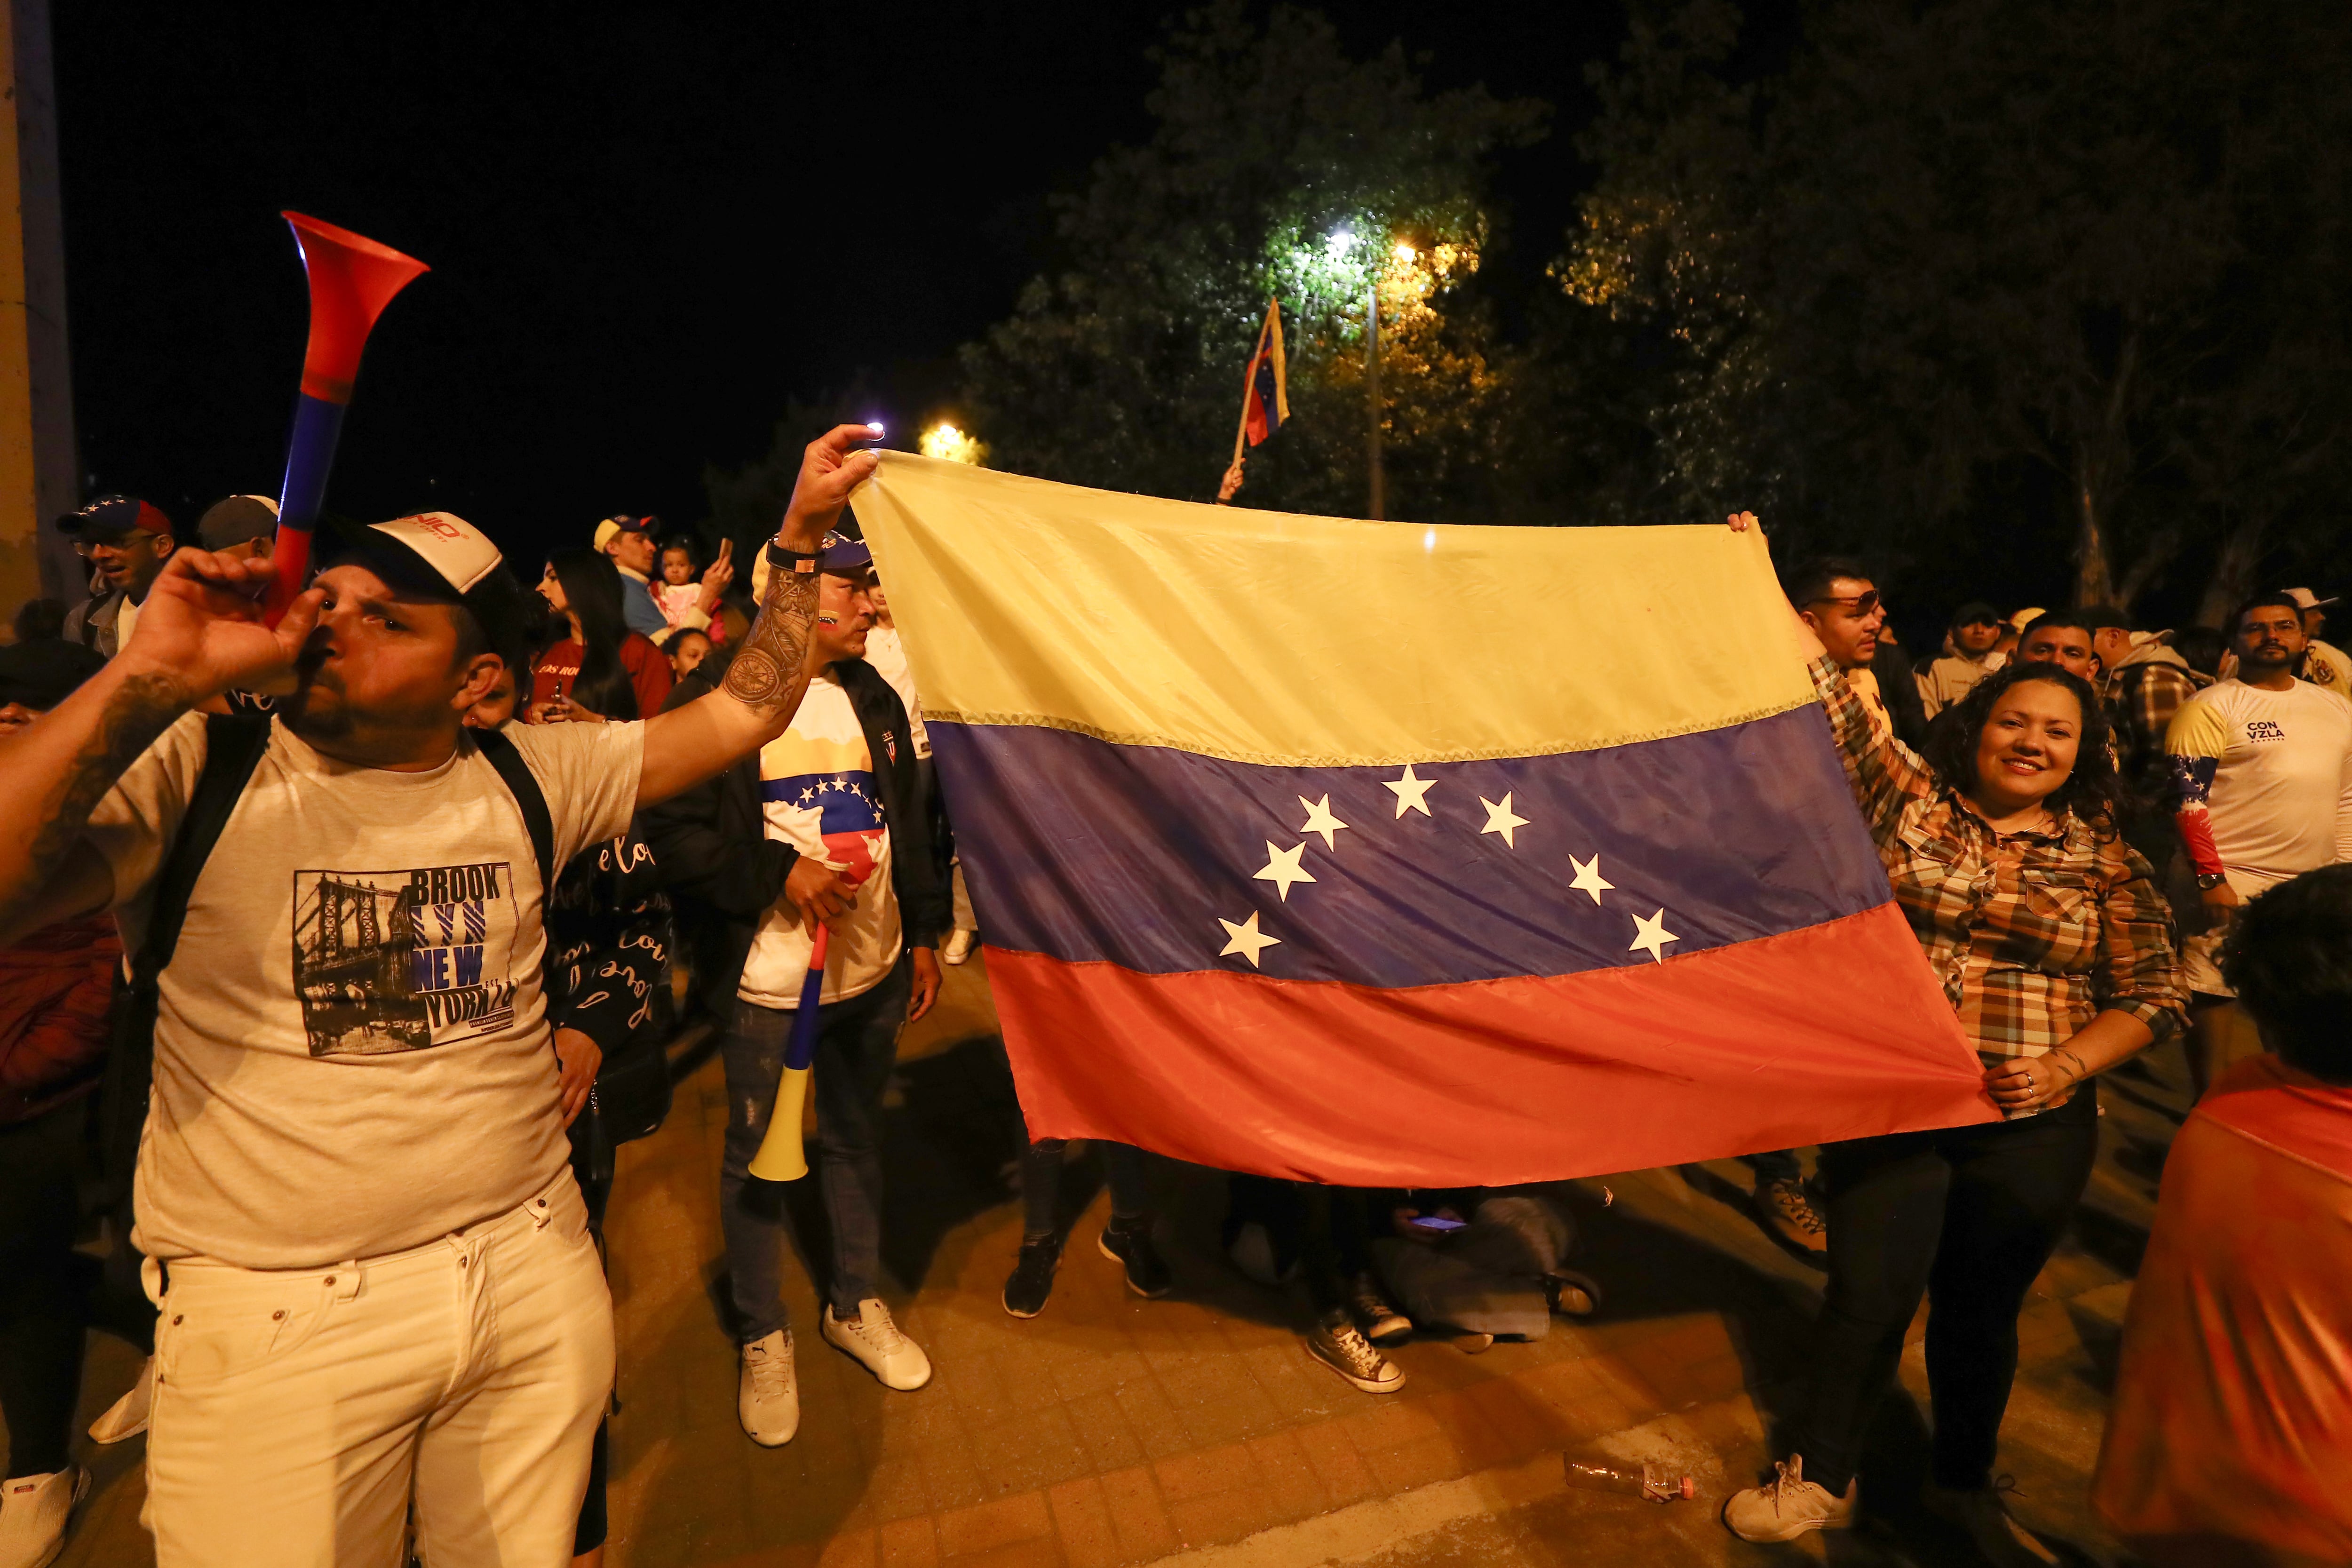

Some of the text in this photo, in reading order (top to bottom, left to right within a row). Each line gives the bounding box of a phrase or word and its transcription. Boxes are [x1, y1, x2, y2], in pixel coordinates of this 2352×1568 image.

[2247, 730, 2285, 739] VZLA
[2248, 721, 2278, 730] CON
[410, 865, 500, 906] BROOK
[410, 945, 483, 992] NEW
